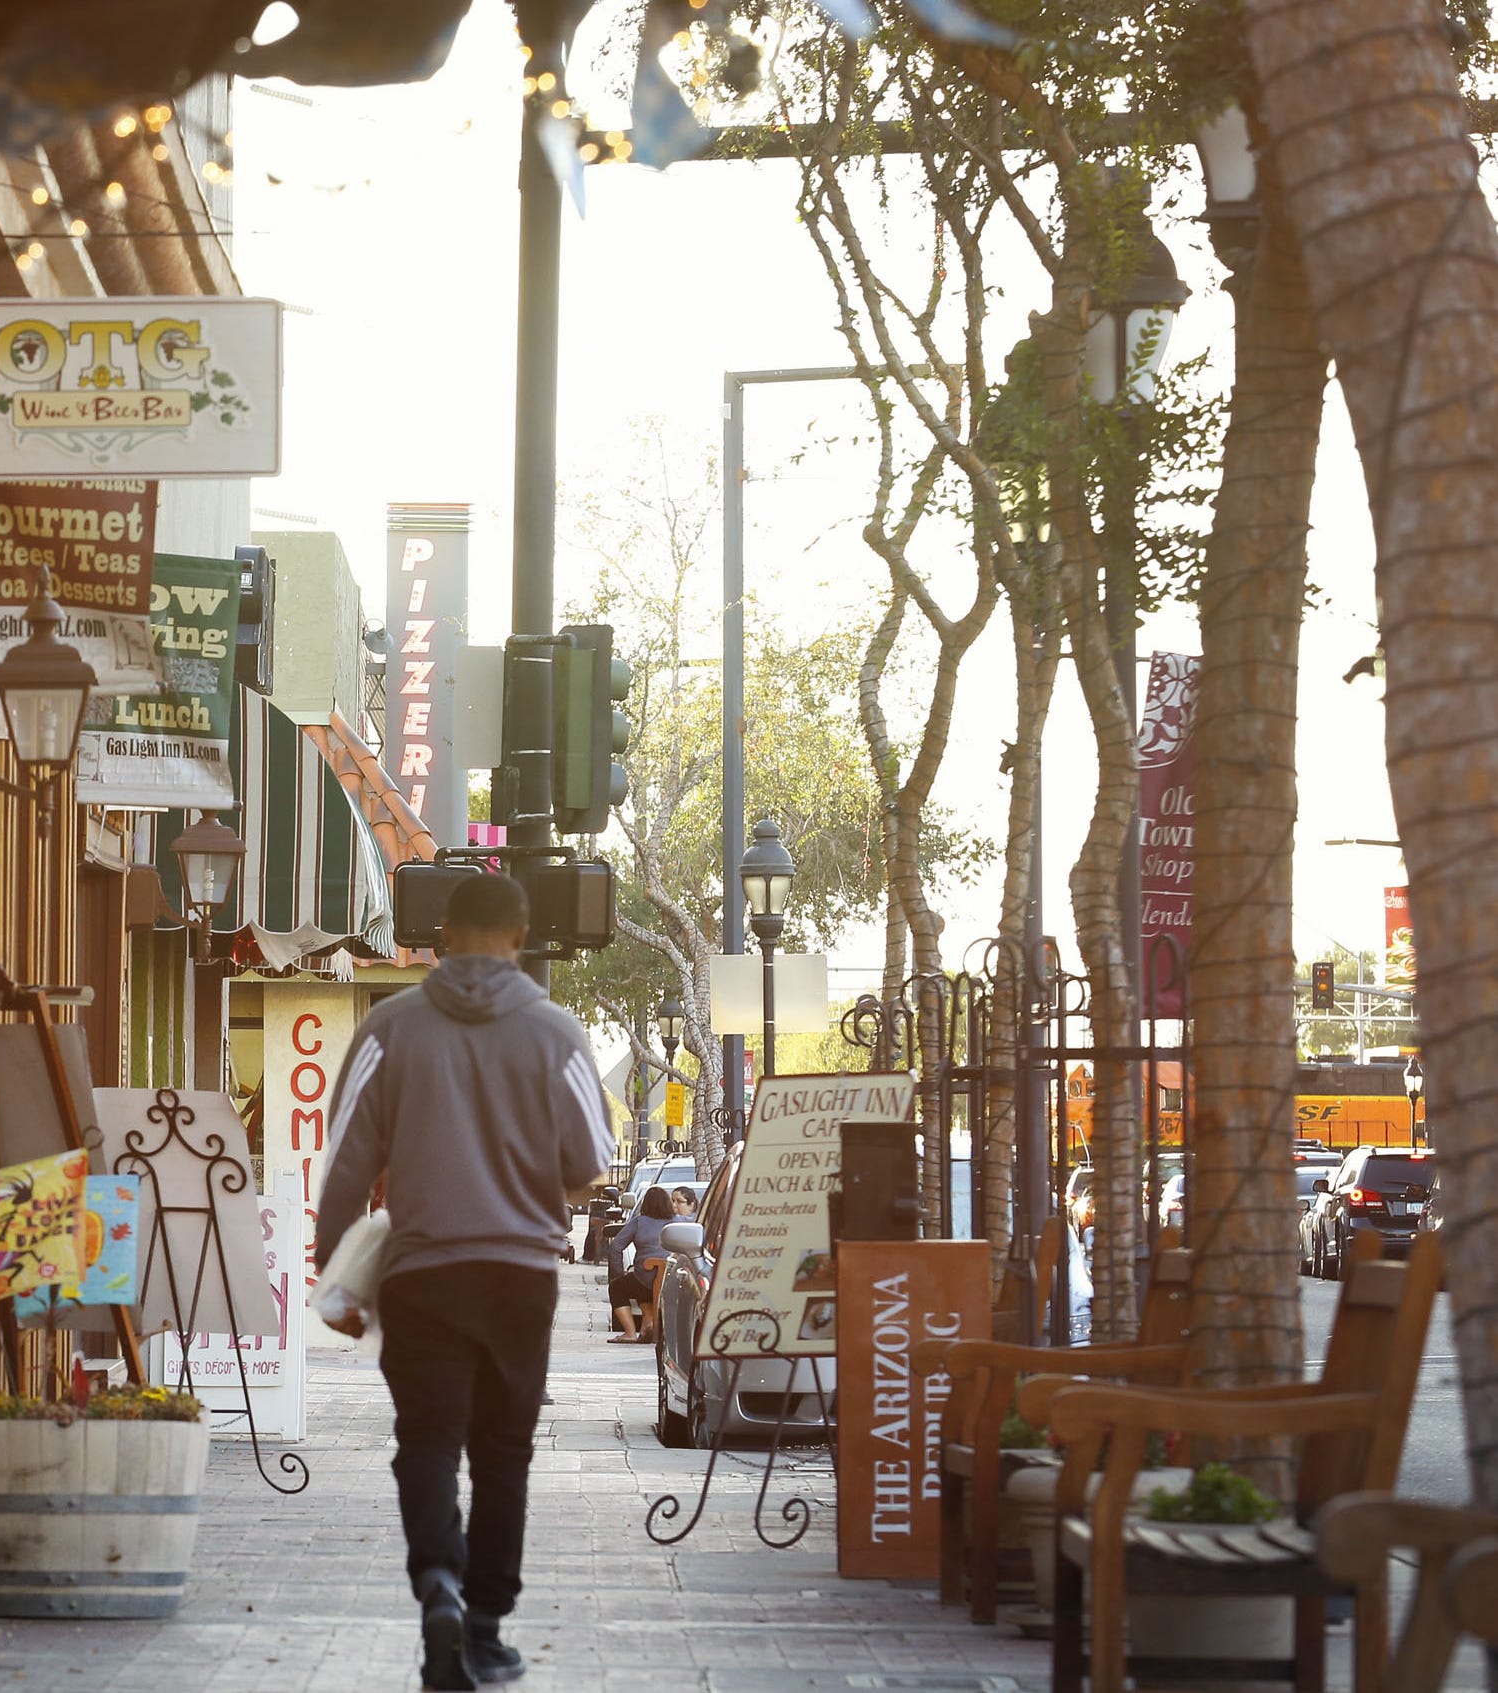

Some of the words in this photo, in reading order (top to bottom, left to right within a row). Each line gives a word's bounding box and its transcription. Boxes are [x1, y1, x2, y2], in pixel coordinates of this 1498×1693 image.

[21, 397, 70, 421] Wine
[94, 396, 140, 421] Beer
[142, 396, 183, 421] Bar
[74, 544, 141, 574] Teas
[150, 584, 229, 616] ow
[400, 537, 437, 818] PIZZERI
[116, 694, 212, 732] Lunch
[106, 737, 127, 756] Gas
[129, 739, 159, 759] Light
[161, 741, 181, 758] Inn
[1141, 898, 1193, 926] lend
[760, 1087, 860, 1122] GASLIGHT
[865, 1087, 906, 1118] INN
[1296, 1105, 1342, 1121] SF
[778, 1152, 823, 1169] OPEN
[744, 1175, 801, 1194] LUNCH
[803, 1176, 815, 1192] &
[742, 1203, 817, 1216] Bruschetta
[736, 1223, 790, 1238] Paninis
[732, 1245, 784, 1259] Dessert
[727, 1266, 773, 1282] Coffee
[723, 1287, 761, 1301] Wine
[743, 1329, 769, 1342] Ba
[870, 1272, 912, 1450] ARIZONA
[870, 1459, 911, 1544] THE
